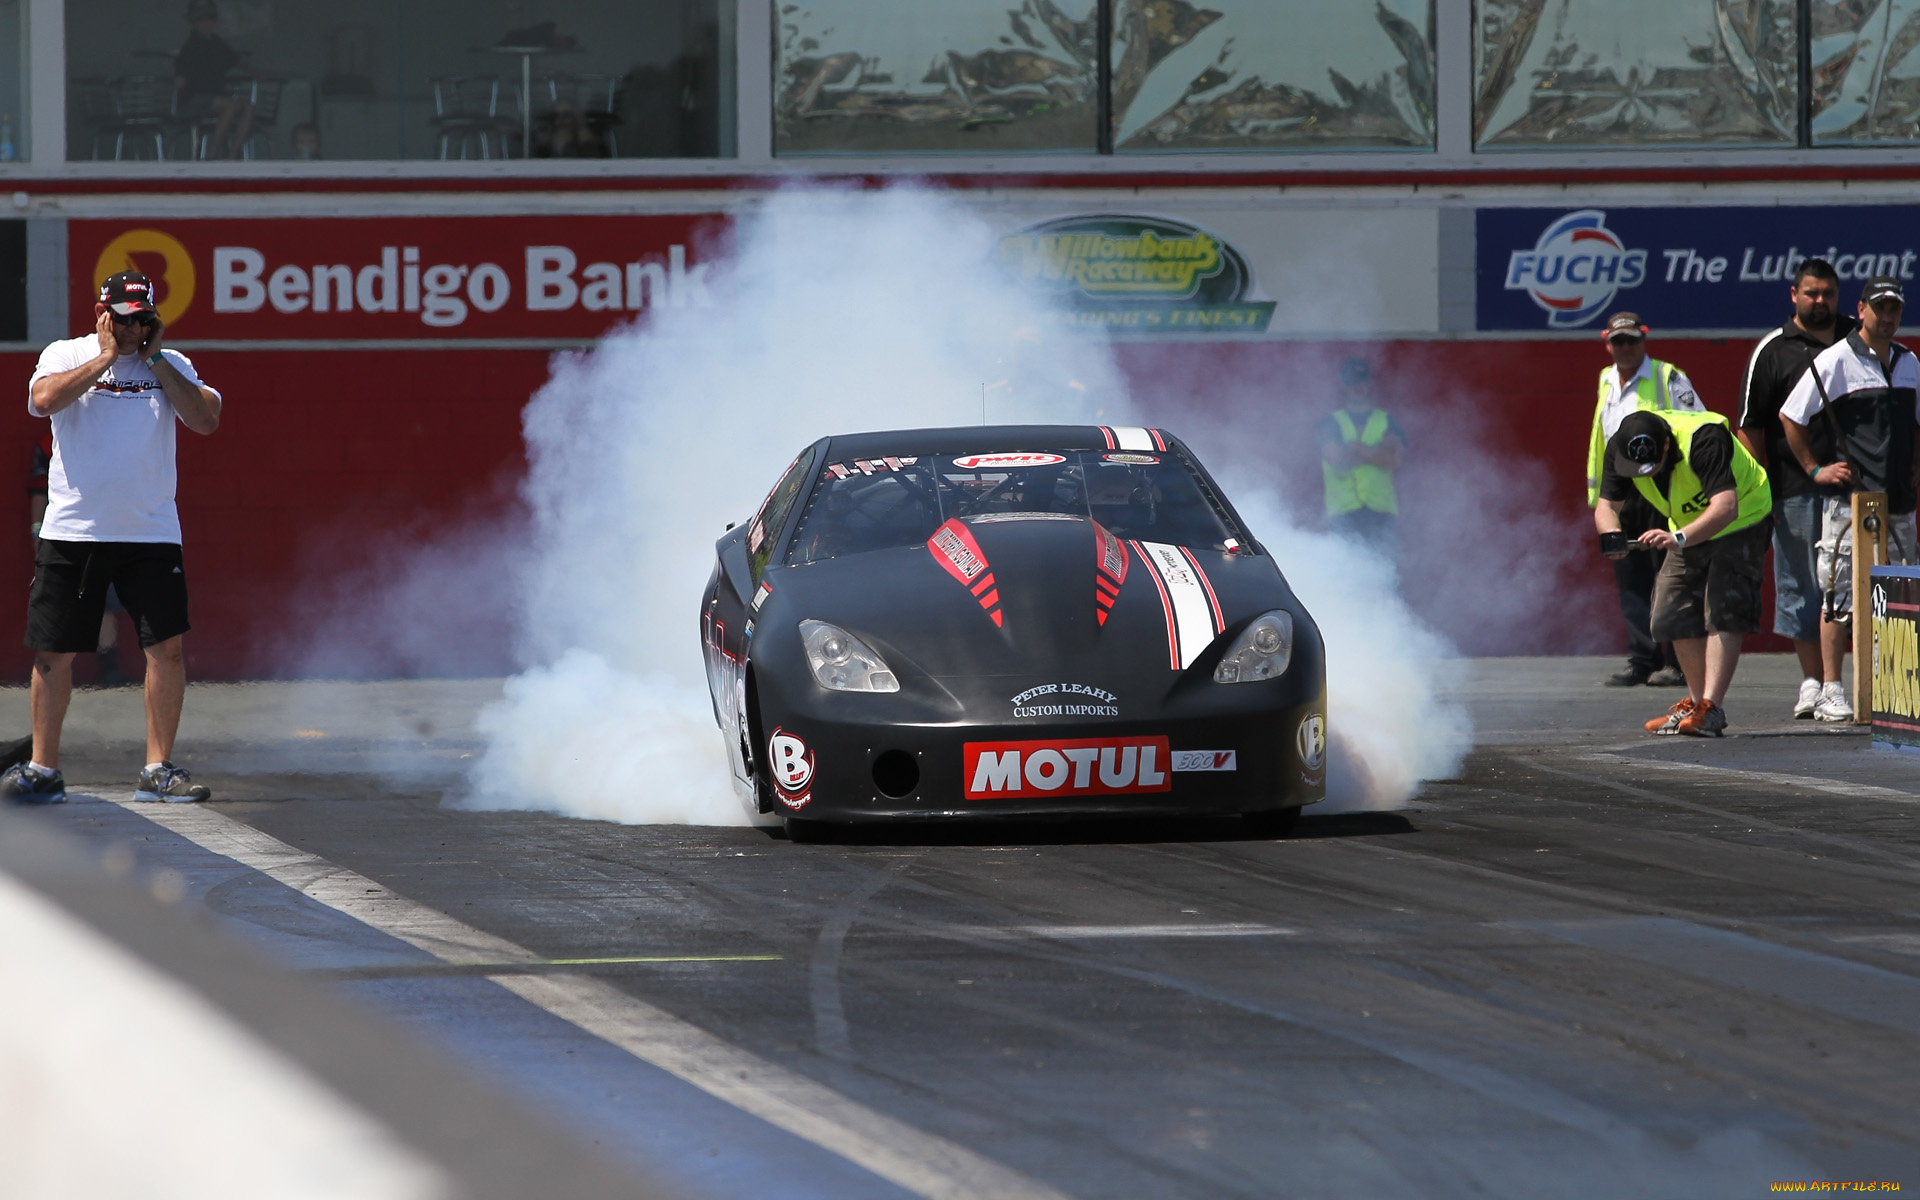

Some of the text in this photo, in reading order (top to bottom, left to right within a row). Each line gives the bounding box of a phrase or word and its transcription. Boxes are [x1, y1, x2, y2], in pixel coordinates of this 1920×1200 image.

[1065, 257, 1196, 292] Raceway
[1511, 254, 1644, 286] FUCHS
[1662, 248, 1729, 283] The
[212, 245, 511, 328] Bendigo
[525, 243, 712, 312] Bank
[1170, 309, 1262, 326] FINEST
[1010, 683, 1118, 707] PETER LEAHY
[1013, 704, 1119, 718] CUSTOM IMPORTS
[970, 745, 1232, 793] MOTUL 300V
